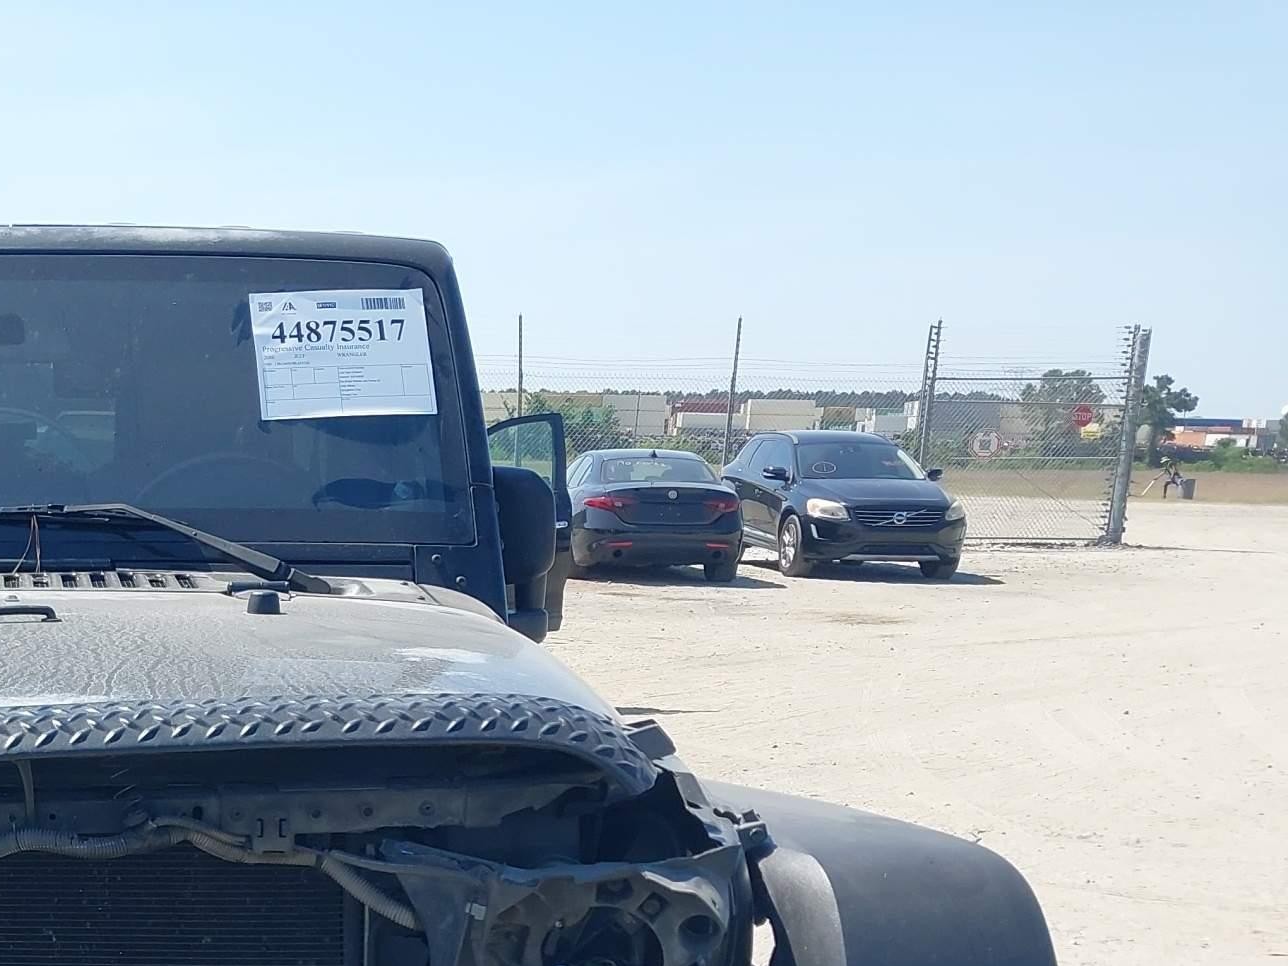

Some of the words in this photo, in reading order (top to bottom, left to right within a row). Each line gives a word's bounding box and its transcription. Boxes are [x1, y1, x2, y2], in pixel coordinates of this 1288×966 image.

[271, 319, 405, 343] 44875517
[262, 345, 303, 353] Progressive
[304, 344, 334, 352] Casualty
[1073, 412, 1092, 421] STOP
